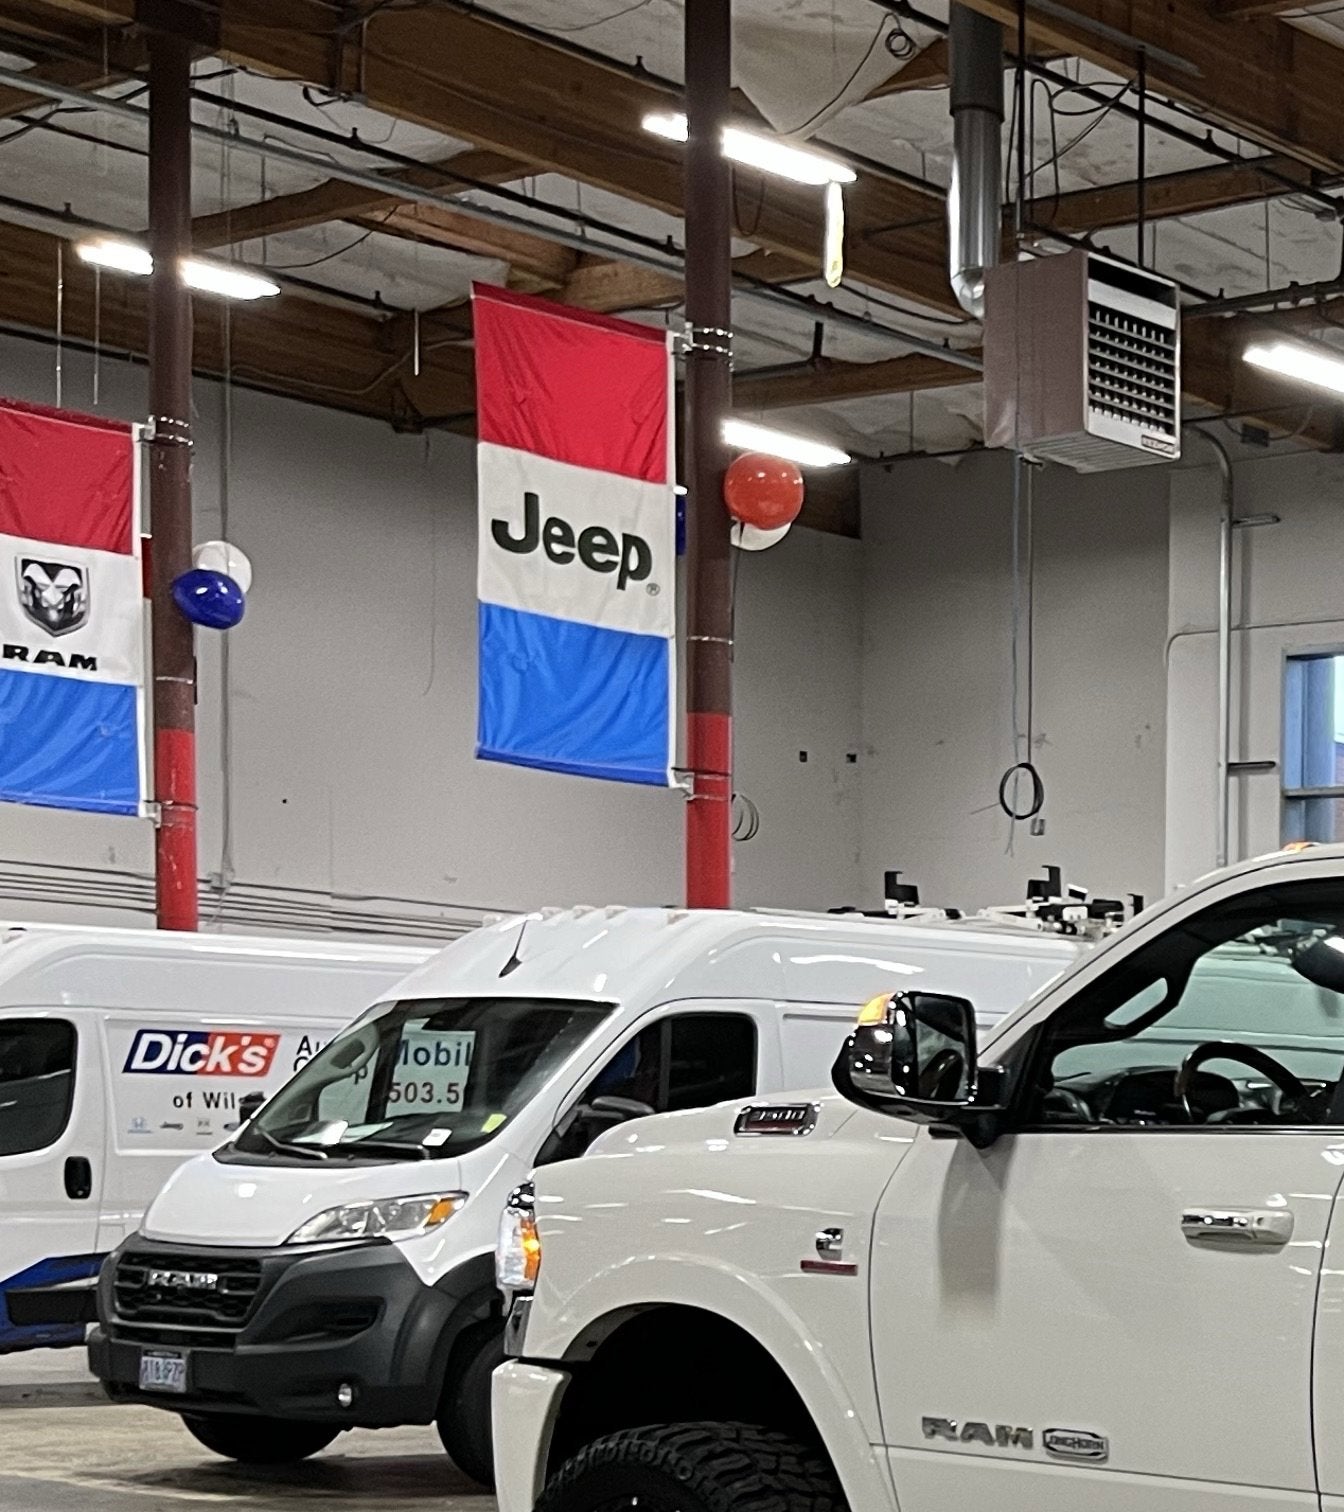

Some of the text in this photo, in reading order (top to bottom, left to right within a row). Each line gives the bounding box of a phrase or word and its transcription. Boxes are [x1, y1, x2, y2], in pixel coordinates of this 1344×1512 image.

[491, 491, 654, 591] Jeep
[2, 643, 98, 671] RAM
[130, 1032, 268, 1074] Dick's
[172, 1091, 193, 1109] of
[921, 1416, 1034, 1450] RAM
